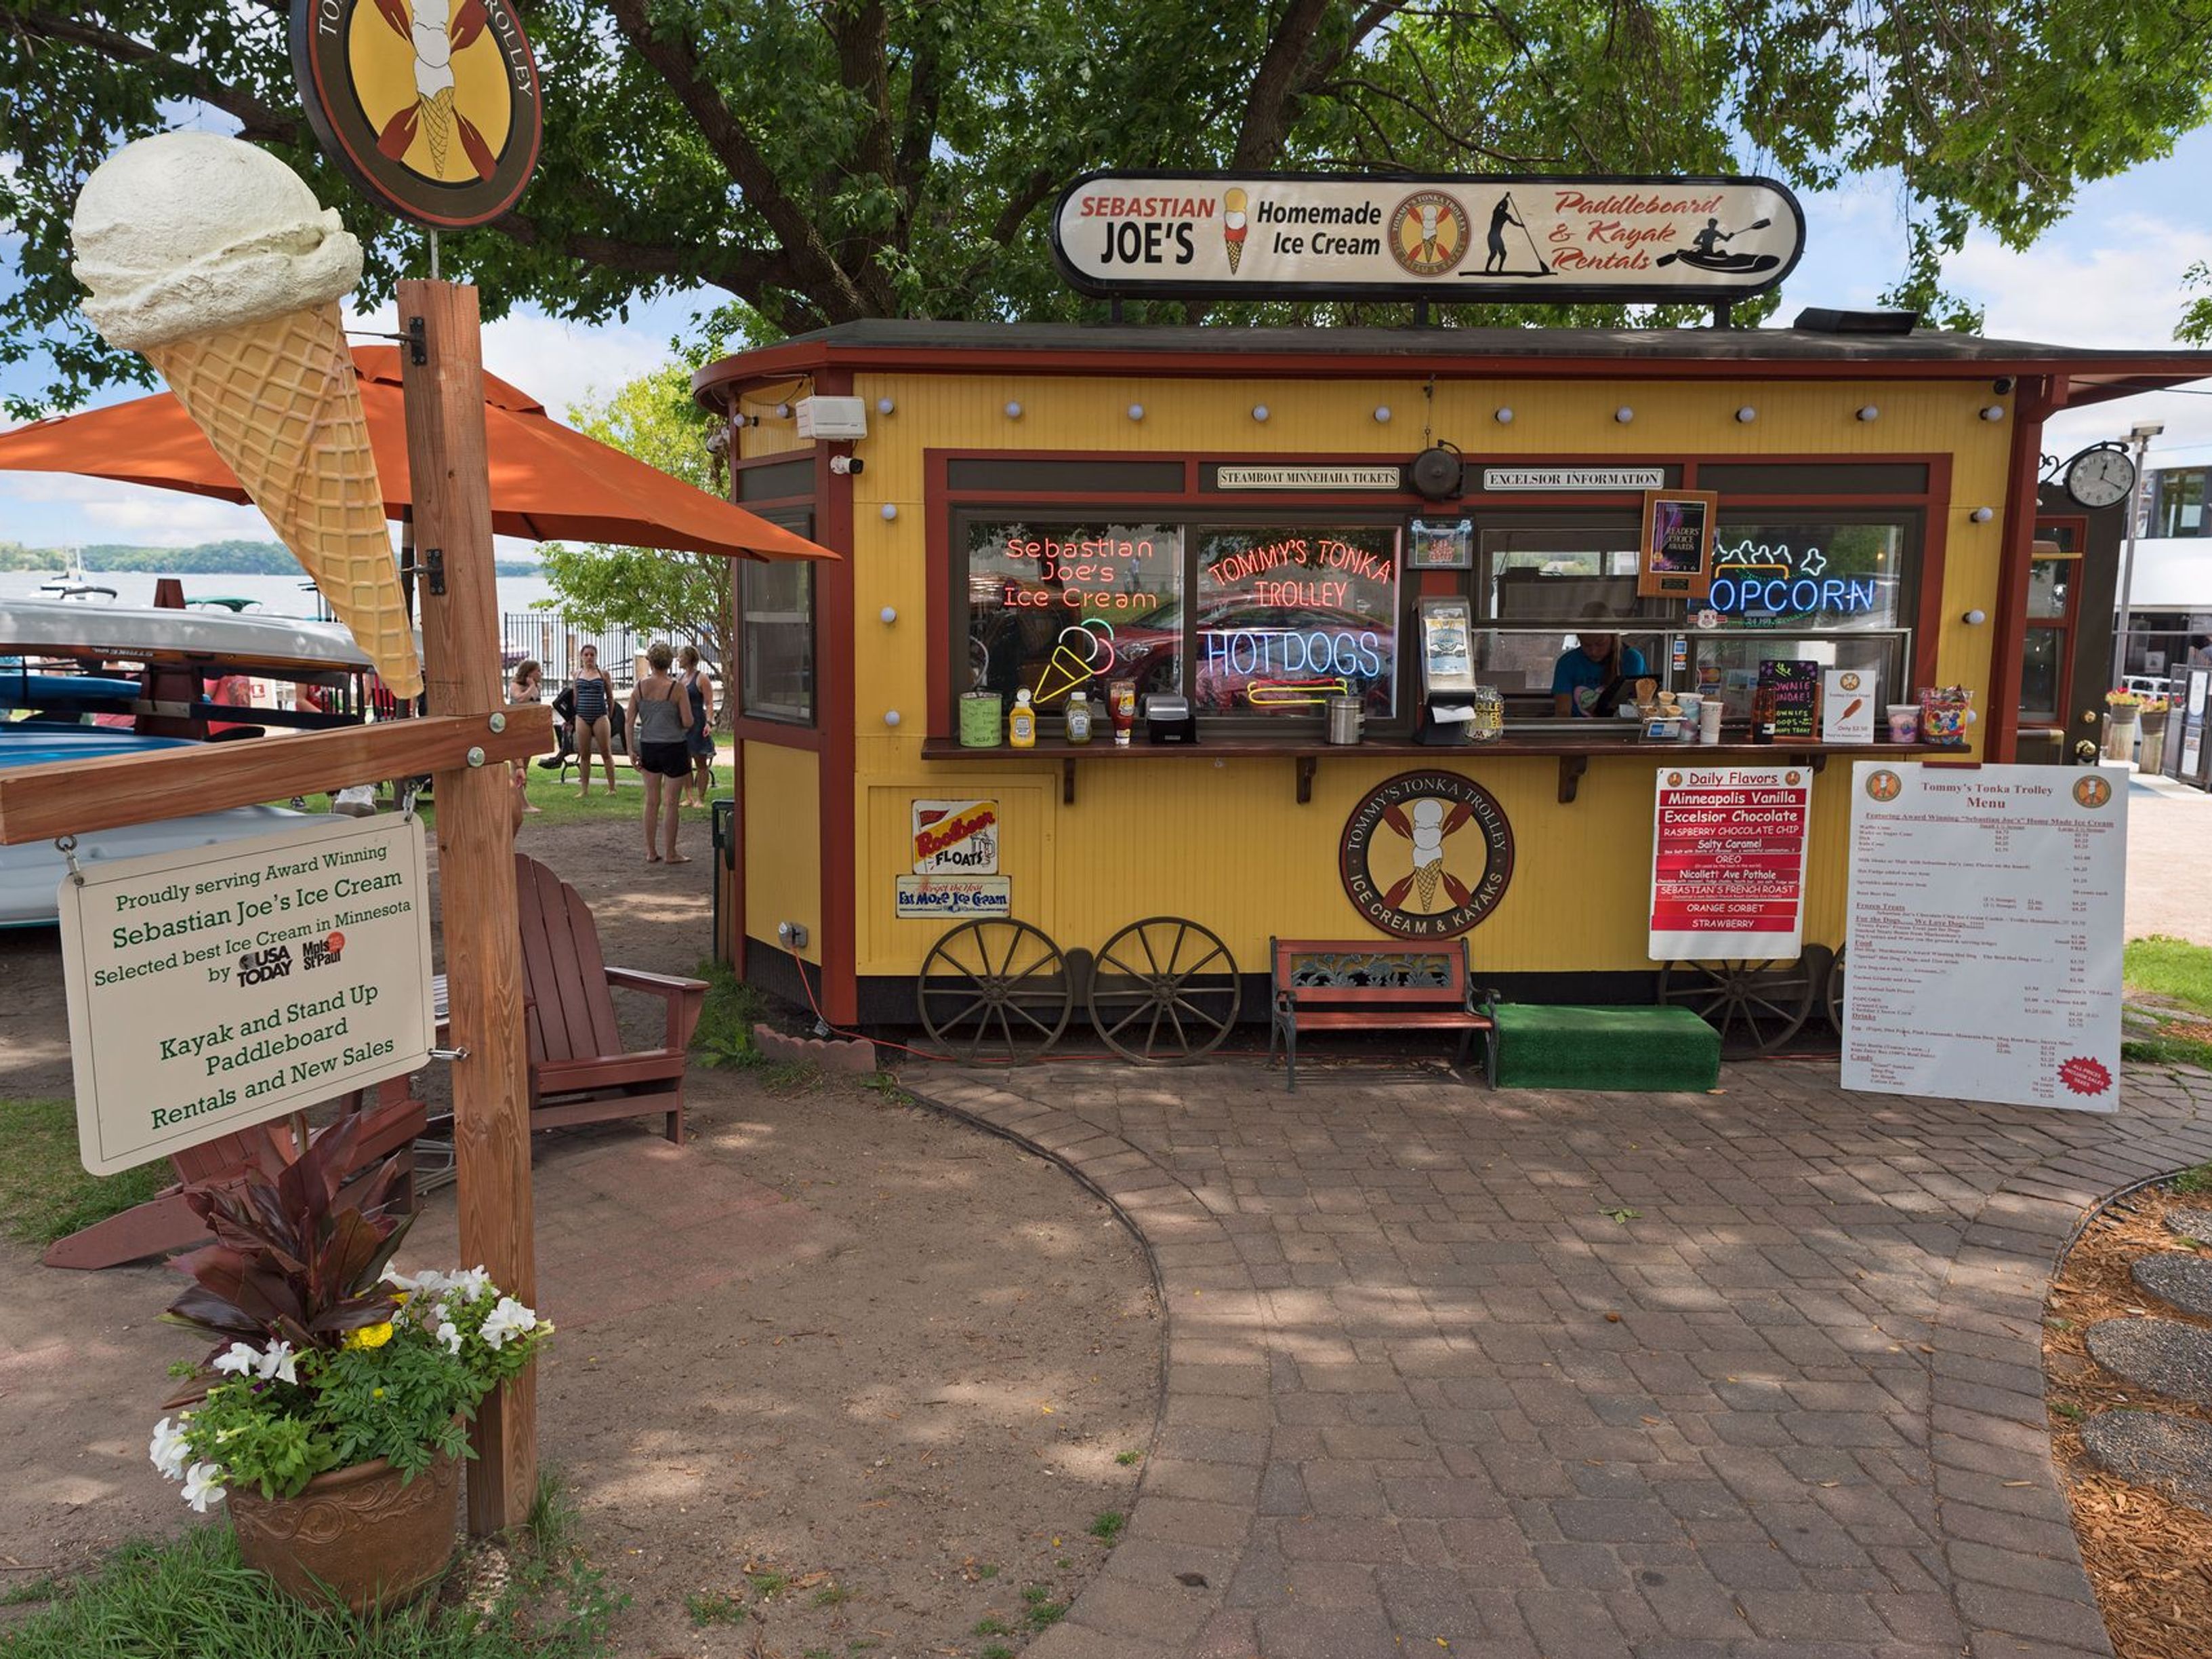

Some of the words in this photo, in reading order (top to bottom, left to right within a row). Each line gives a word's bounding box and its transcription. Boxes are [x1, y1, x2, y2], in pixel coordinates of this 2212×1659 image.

[483, 0, 533, 98] ROLLEY
[1080, 197, 1216, 218] SEBASTIAN
[1257, 201, 1382, 224] Homemade
[1555, 191, 1723, 214] Paddleboard
[1101, 222, 1195, 264] JOE'S
[1273, 232, 1303, 254] Ice
[1311, 233, 1380, 255] Cream
[1549, 223, 1576, 242] &
[1587, 220, 1676, 249] Kayak
[1552, 247, 1651, 270] Rentals
[1221, 472, 1285, 483] STEAMBOAT
[1288, 472, 1349, 483] MINNEHAHA
[1353, 472, 1396, 483] TICKETS
[1490, 474, 1561, 485] EXCELSIOR
[1566, 474, 1659, 485] INFORMATION
[1006, 538, 1152, 558] Sebastian
[1041, 561, 1114, 582] Joe's
[1208, 539, 1307, 586] TOMMY'S
[1318, 540, 1391, 585] TONKA
[1004, 587, 1049, 607] Ice
[1063, 587, 1157, 609] Cream
[1254, 581, 1347, 607] TROLLEY
[1686, 579, 1874, 611] OPCORN
[1207, 631, 1277, 676] HOT
[1283, 631, 1380, 677] DOGS
[1690, 772, 1723, 787] Daily
[1729, 772, 1778, 784] Flavors
[1921, 782, 1972, 794] Tommy's
[1975, 783, 2010, 794] Tonka
[2014, 784, 2053, 796] Trolley
[1668, 792, 1746, 806] Minneapolis
[1751, 790, 1796, 804] Vanilla
[1967, 796, 2006, 808] Menu
[1347, 786, 1401, 851] TOMMY'S
[1401, 778, 1459, 795] TONKA
[1465, 788, 1507, 851] TROLLEY
[1664, 809, 1727, 823] Excelsior
[1732, 808, 1798, 823] Chocolate
[1866, 813, 1900, 821] Featuring
[1927, 814, 1959, 823] Winning
[2026, 817, 2049, 825] Home
[2050, 818, 2072, 826] Made
[2087, 820, 2114, 828] Cream
[1664, 827, 1717, 837] RASPBERRY
[1718, 825, 1774, 836] CHOCOLATE
[1776, 825, 1800, 834] CHIP
[1698, 840, 1723, 849] Salty
[1725, 838, 1763, 848] Caramel
[935, 851, 983, 866] FLOATS
[1715, 855, 1742, 864] OREO
[116, 884, 189, 912] Proudly
[195, 872, 261, 895] serving
[265, 857, 319, 880] Award
[322, 846, 387, 868] Winning
[1723, 869, 1740, 880] Ave
[1743, 870, 1777, 880] Pothole
[899, 891, 914, 905] Eat
[916, 892, 949, 905] More
[953, 892, 970, 904] Ice
[972, 892, 1007, 906] Cream
[1661, 885, 1723, 895] SEBASTIAN'S
[1725, 884, 1761, 894] FRENCH
[1763, 884, 1795, 893] ROAST
[112, 909, 232, 949] Sebastian
[237, 894, 291, 926] Joe's
[296, 888, 329, 907] Ice
[334, 872, 403, 898] Cream
[1349, 874, 1373, 904] ICE
[1370, 903, 1427, 933] CREAM
[1436, 919, 1447, 933] &
[1452, 872, 1502, 927] KAYAKS
[1687, 903, 1725, 913] ORANGE
[1727, 903, 1764, 913] SORBET
[1692, 919, 1755, 928] STRAWBERRY
[94, 953, 178, 987] Selected
[183, 944, 221, 965] best
[225, 939, 251, 955] Ice
[256, 925, 312, 946] Cream
[316, 918, 331, 933] in
[335, 901, 411, 928] Minnesota
[302, 939, 330, 959] Mpls
[208, 966, 231, 983] by
[254, 945, 291, 966] USA
[237, 959, 293, 987] TODAY
[159, 1024, 235, 1061] Kayak
[239, 1008, 283, 1037] and
[285, 991, 346, 1023] Stand
[350, 984, 379, 1006] Up
[205, 1017, 349, 1076] Paddleboard
[150, 1088, 238, 1130] Rentals
[244, 1070, 287, 1099] and
[289, 1055, 340, 1084] New
[342, 1038, 395, 1067] Sales
